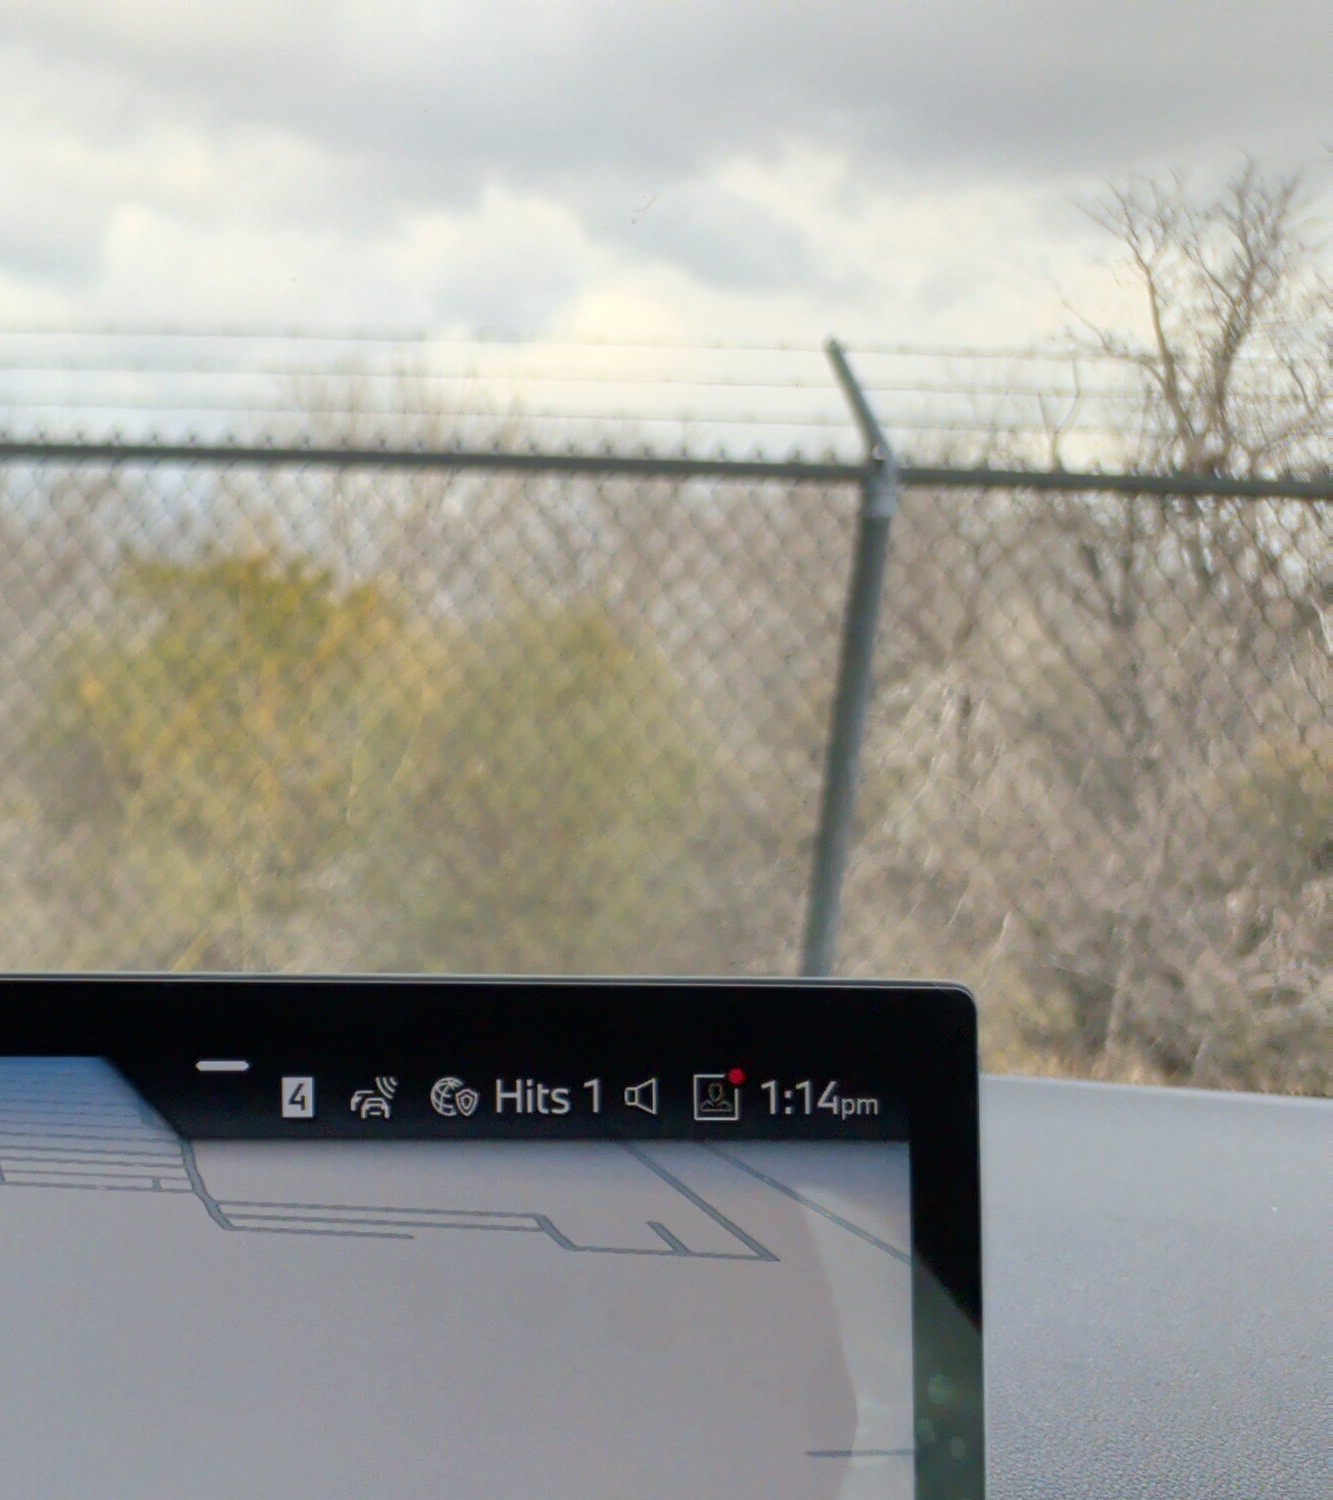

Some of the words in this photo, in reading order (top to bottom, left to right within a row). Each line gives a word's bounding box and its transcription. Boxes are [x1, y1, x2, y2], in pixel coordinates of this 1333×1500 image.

[287, 1081, 308, 1114] 4
[495, 1080, 571, 1115] Hits
[584, 1079, 602, 1114] 1
